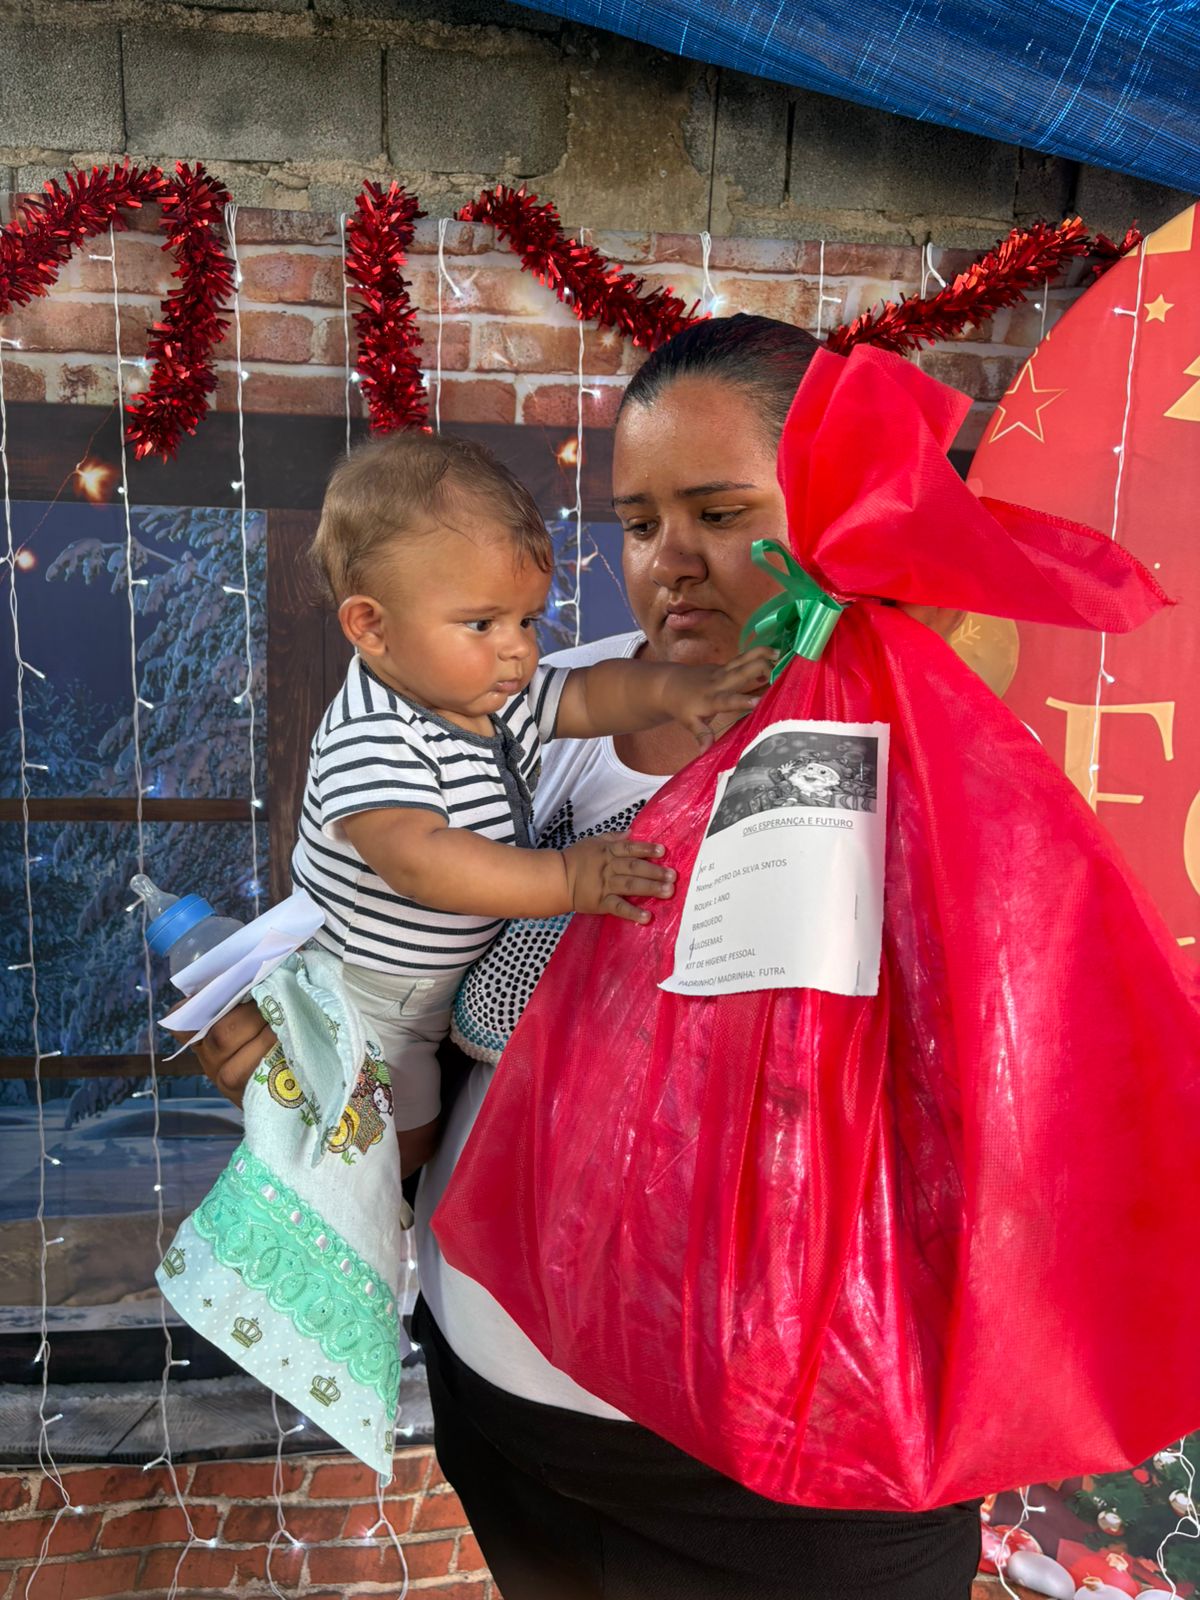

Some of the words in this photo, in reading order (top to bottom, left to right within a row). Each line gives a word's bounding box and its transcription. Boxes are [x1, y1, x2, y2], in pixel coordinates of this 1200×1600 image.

[742, 824, 758, 836] ONG
[759, 816, 805, 831] ESPERANÇA
[807, 816, 814, 825] E
[815, 817, 854, 828] FUTURO
[714, 872, 731, 885] PIETRO
[732, 869, 741, 878] DA
[742, 863, 760, 875] SILVA
[760, 858, 787, 870] SNTOS
[717, 892, 730, 903] ANO
[685, 962, 696, 970] KIT
[696, 960, 704, 969] DE
[705, 953, 727, 967] HIGIENE
[728, 948, 756, 961] PESSOAL
[759, 967, 786, 977] FUTRA
